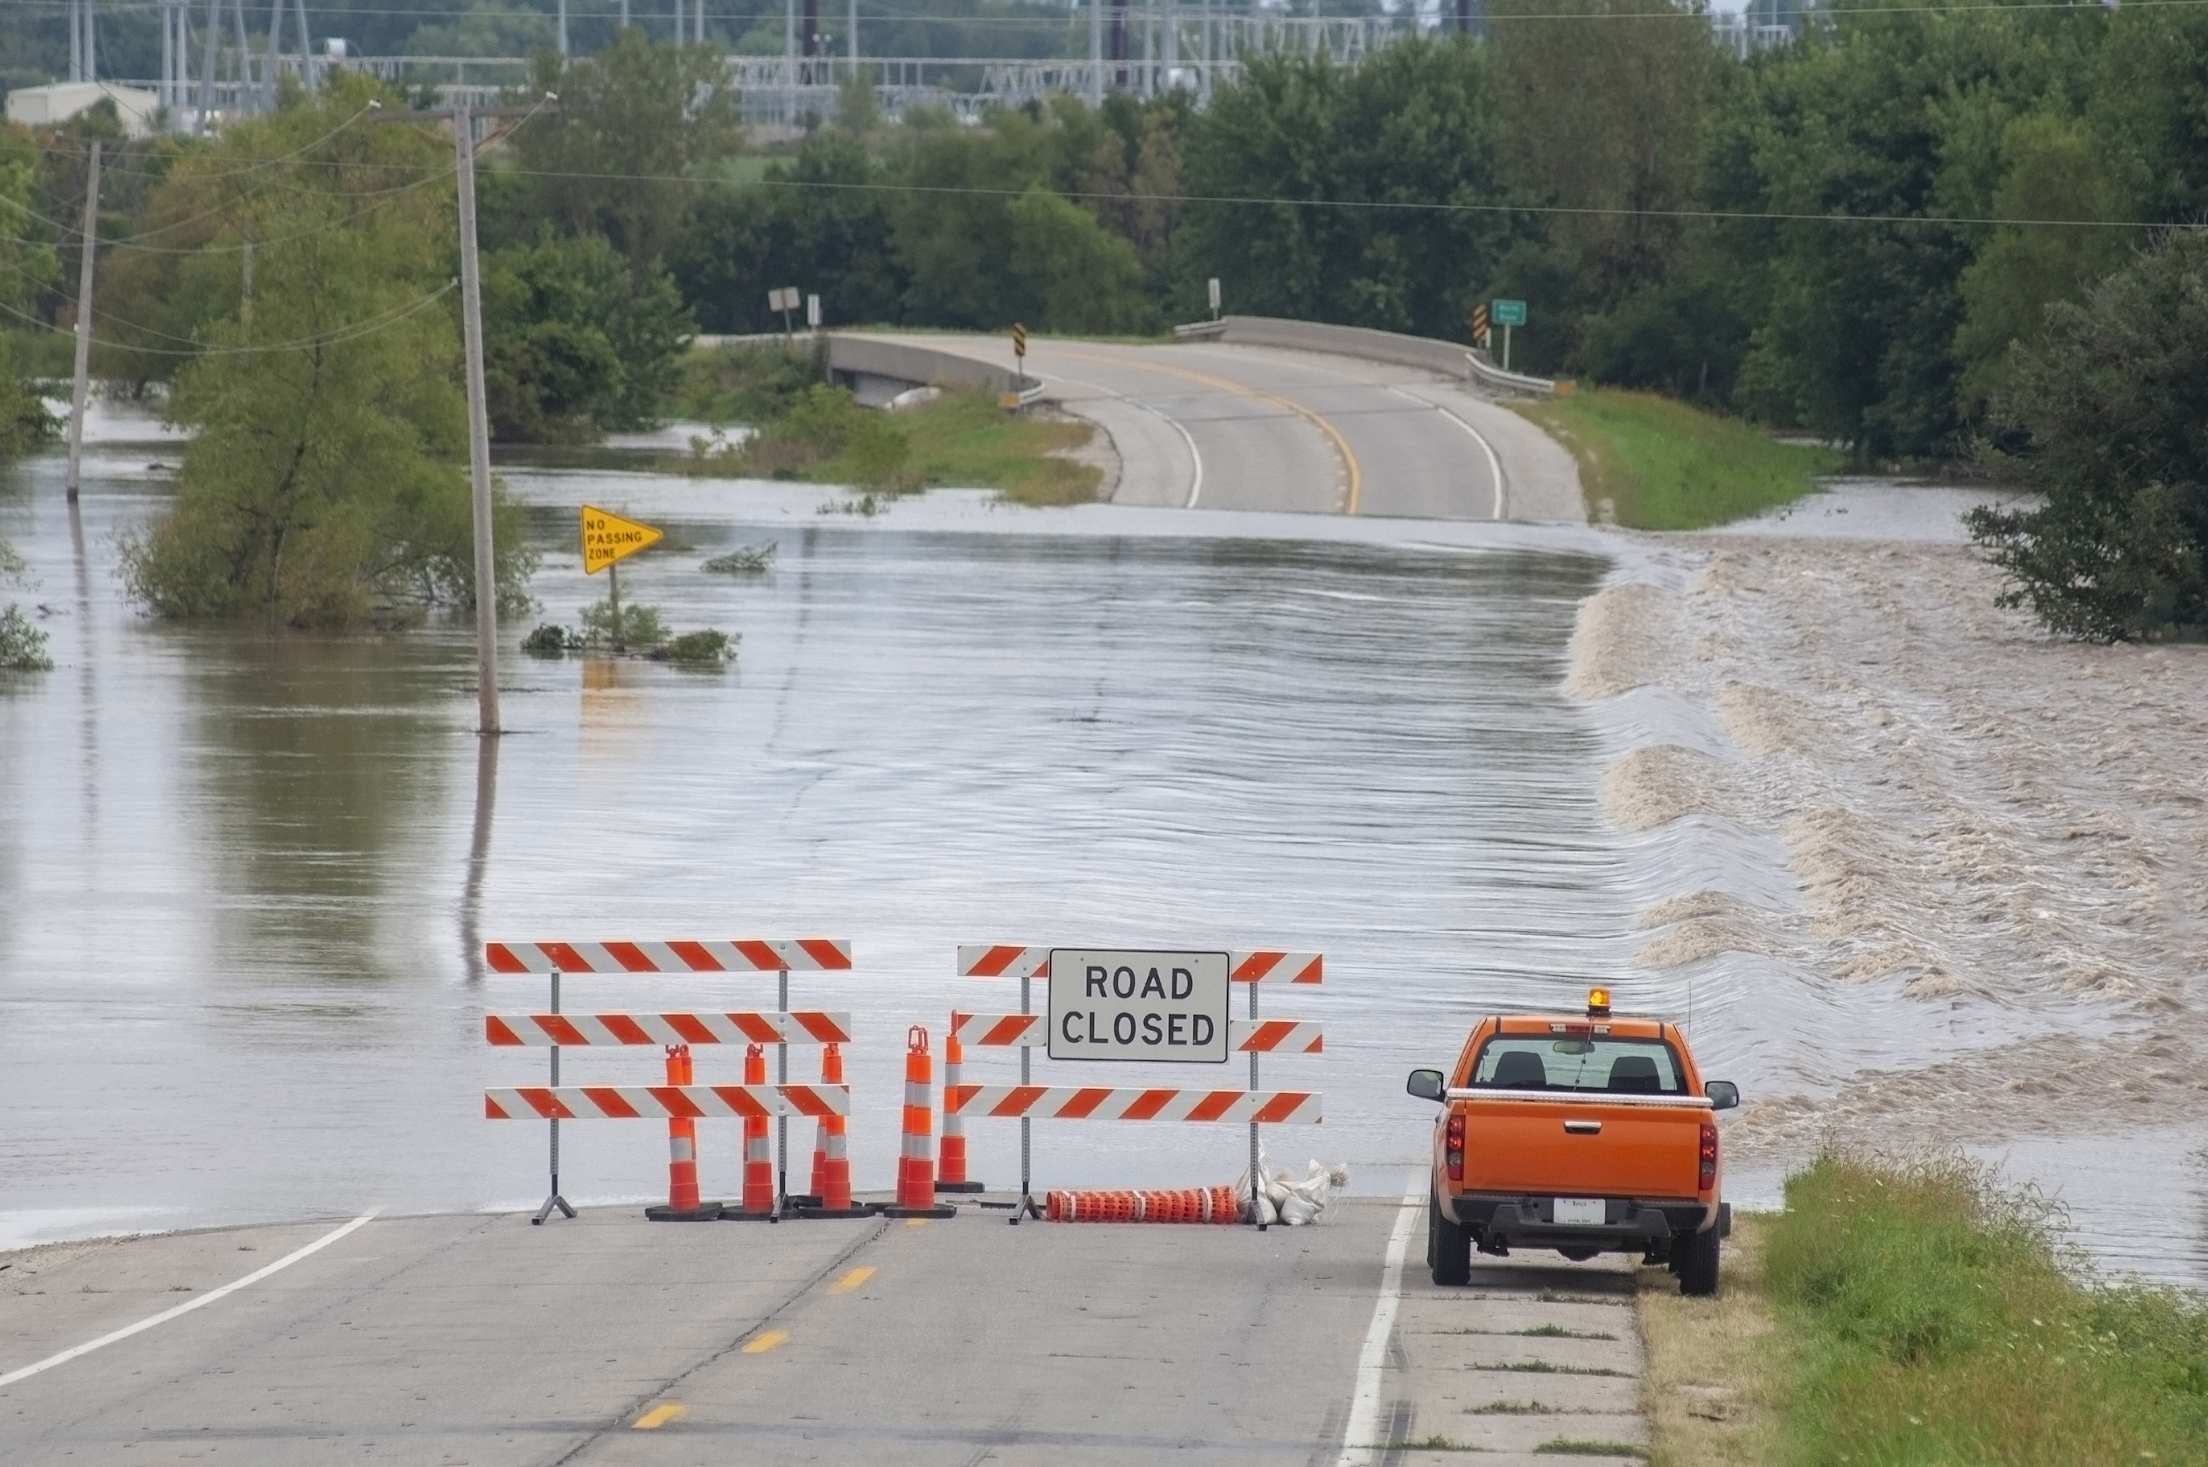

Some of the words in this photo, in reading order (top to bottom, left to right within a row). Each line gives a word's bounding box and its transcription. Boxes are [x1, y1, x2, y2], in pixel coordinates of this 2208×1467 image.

[586, 520, 605, 530] NO
[587, 531, 642, 545] PASSING
[588, 547, 615, 559] ZONE
[1086, 966, 1193, 999] ROAD
[1062, 1011, 1214, 1045] CLOSED
